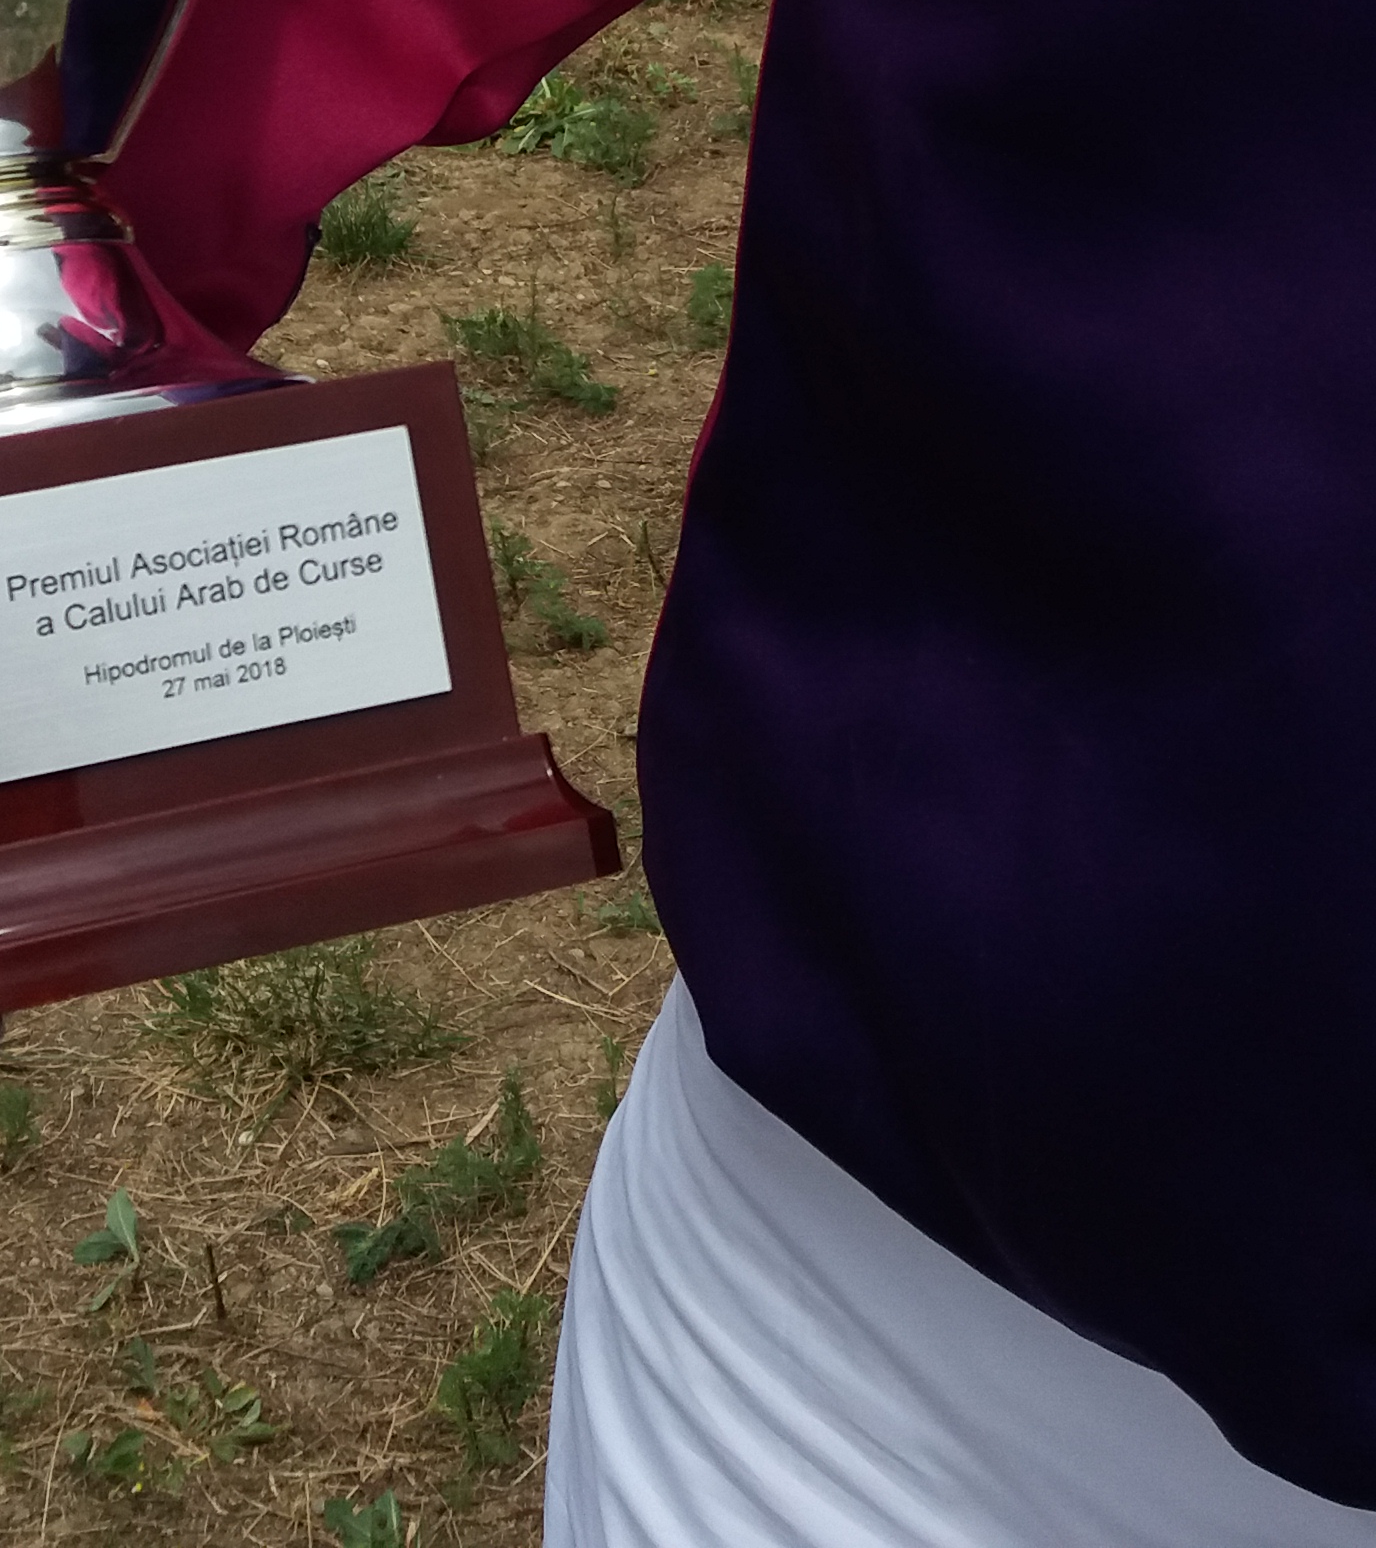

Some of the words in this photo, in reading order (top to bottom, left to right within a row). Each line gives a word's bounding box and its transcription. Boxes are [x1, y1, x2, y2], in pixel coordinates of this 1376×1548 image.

[5, 557, 121, 602] Premiul
[278, 511, 399, 552] Române
[35, 615, 56, 637] a
[64, 589, 167, 631] Calului
[176, 575, 246, 611] Arab
[253, 567, 290, 595] de
[298, 553, 384, 586] Curse
[83, 642, 213, 687] Hipodromul
[219, 638, 247, 659] de
[251, 633, 273, 652] la
[161, 675, 186, 699] 27
[193, 669, 231, 692] mai
[236, 656, 288, 684] 2018
